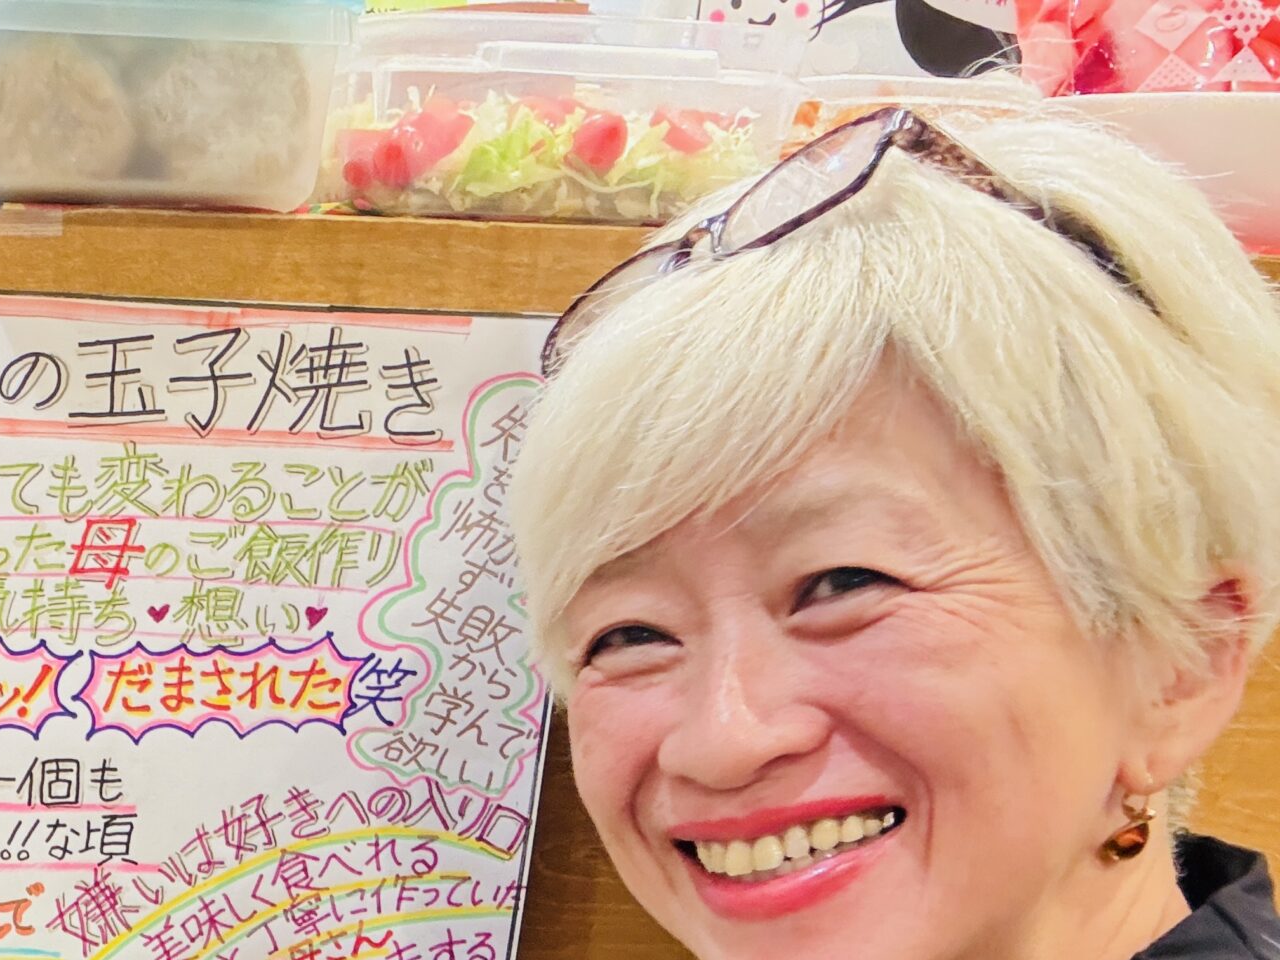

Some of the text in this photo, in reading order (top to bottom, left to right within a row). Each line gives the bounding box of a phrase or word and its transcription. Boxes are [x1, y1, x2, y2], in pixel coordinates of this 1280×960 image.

[102, 657, 342, 713] だまされた
